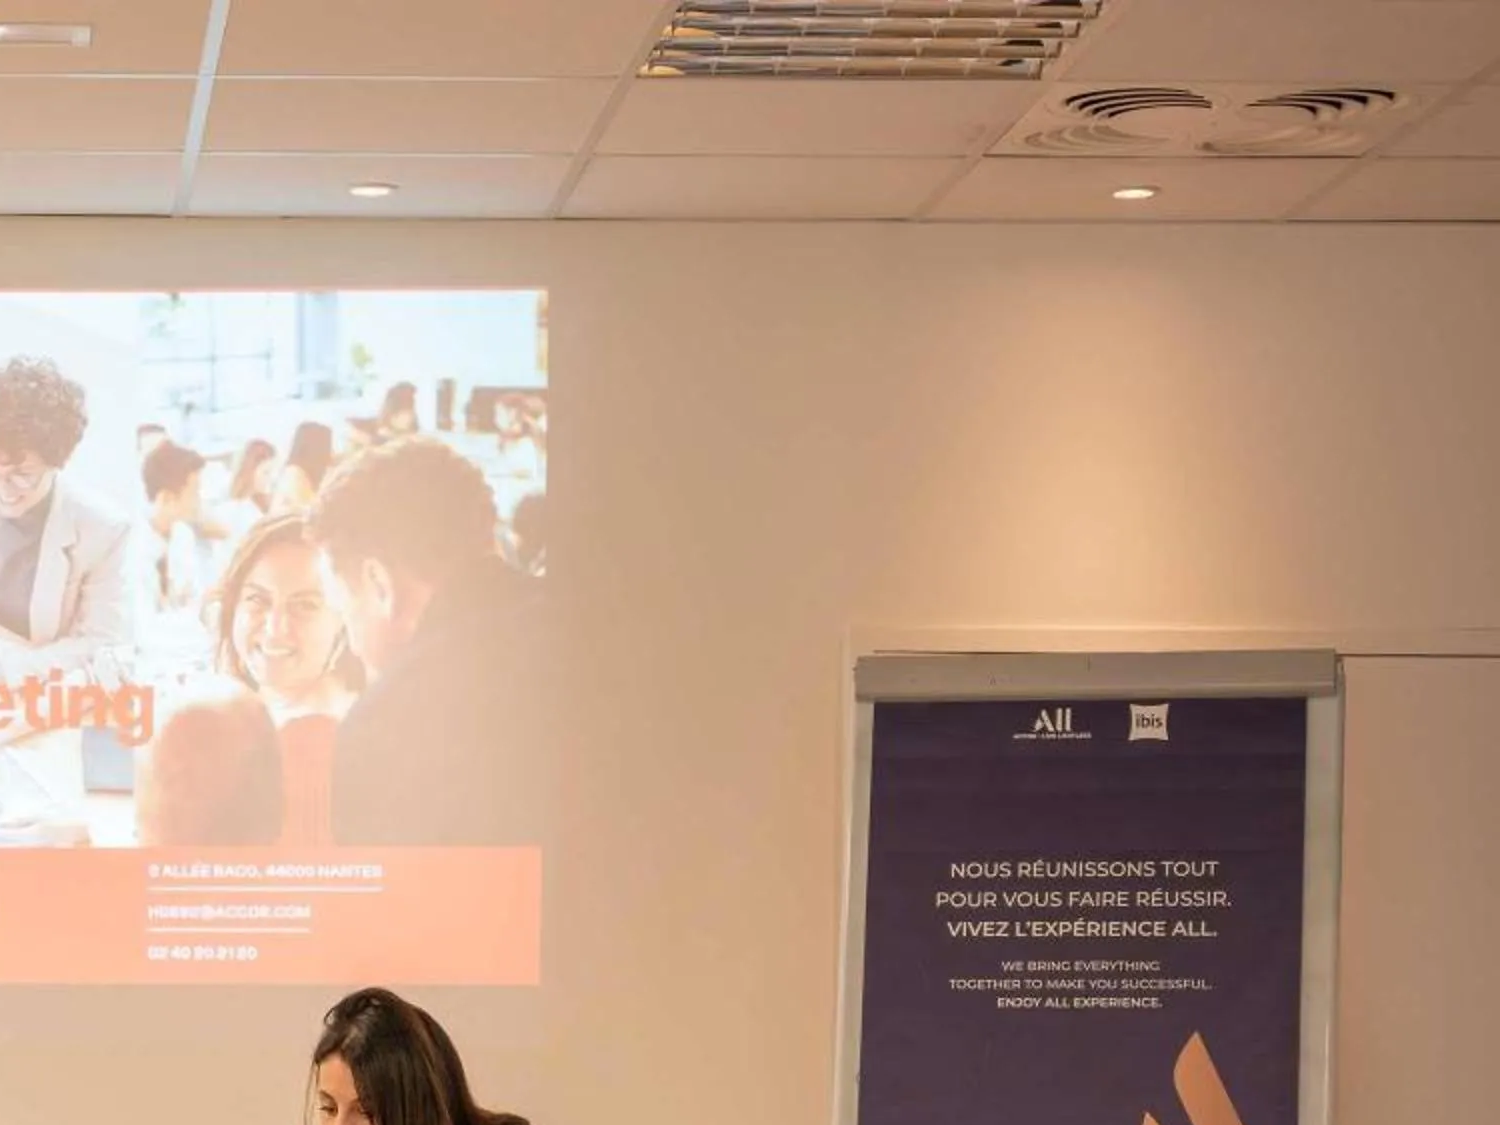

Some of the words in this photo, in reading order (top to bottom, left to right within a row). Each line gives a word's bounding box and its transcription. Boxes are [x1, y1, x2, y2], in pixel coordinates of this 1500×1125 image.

[1134, 712, 1164, 729] ibis
[950, 861, 1013, 879] NOUS
[1019, 857, 1156, 879] RÉUNISSONS
[1161, 860, 1219, 878] TOUT
[936, 891, 998, 909] POUR
[1002, 891, 1063, 909] VOUS
[1069, 890, 1129, 908] FAIRE
[1136, 887, 1232, 908] RÉUSSIR.
[947, 921, 1009, 938] VIVEZ
[1015, 917, 1166, 938] L'EXPÉRIENCE
[1172, 921, 1218, 938] ALL.
[1001, 960, 1023, 972] WE
[1028, 960, 1071, 972] BRING
[1074, 960, 1160, 972] EVERYTHING
[949, 979, 1021, 991] TOGETHER
[1025, 979, 1043, 990] TO
[1047, 979, 1085, 990] MAKE
[1088, 979, 1118, 990] YOU
[1121, 978, 1212, 991] SUCCESSFUL.
[997, 997, 1040, 1009] ENJOY
[1044, 997, 1070, 1009] ALL
[1073, 997, 1163, 1009] EXPERIENCE.
